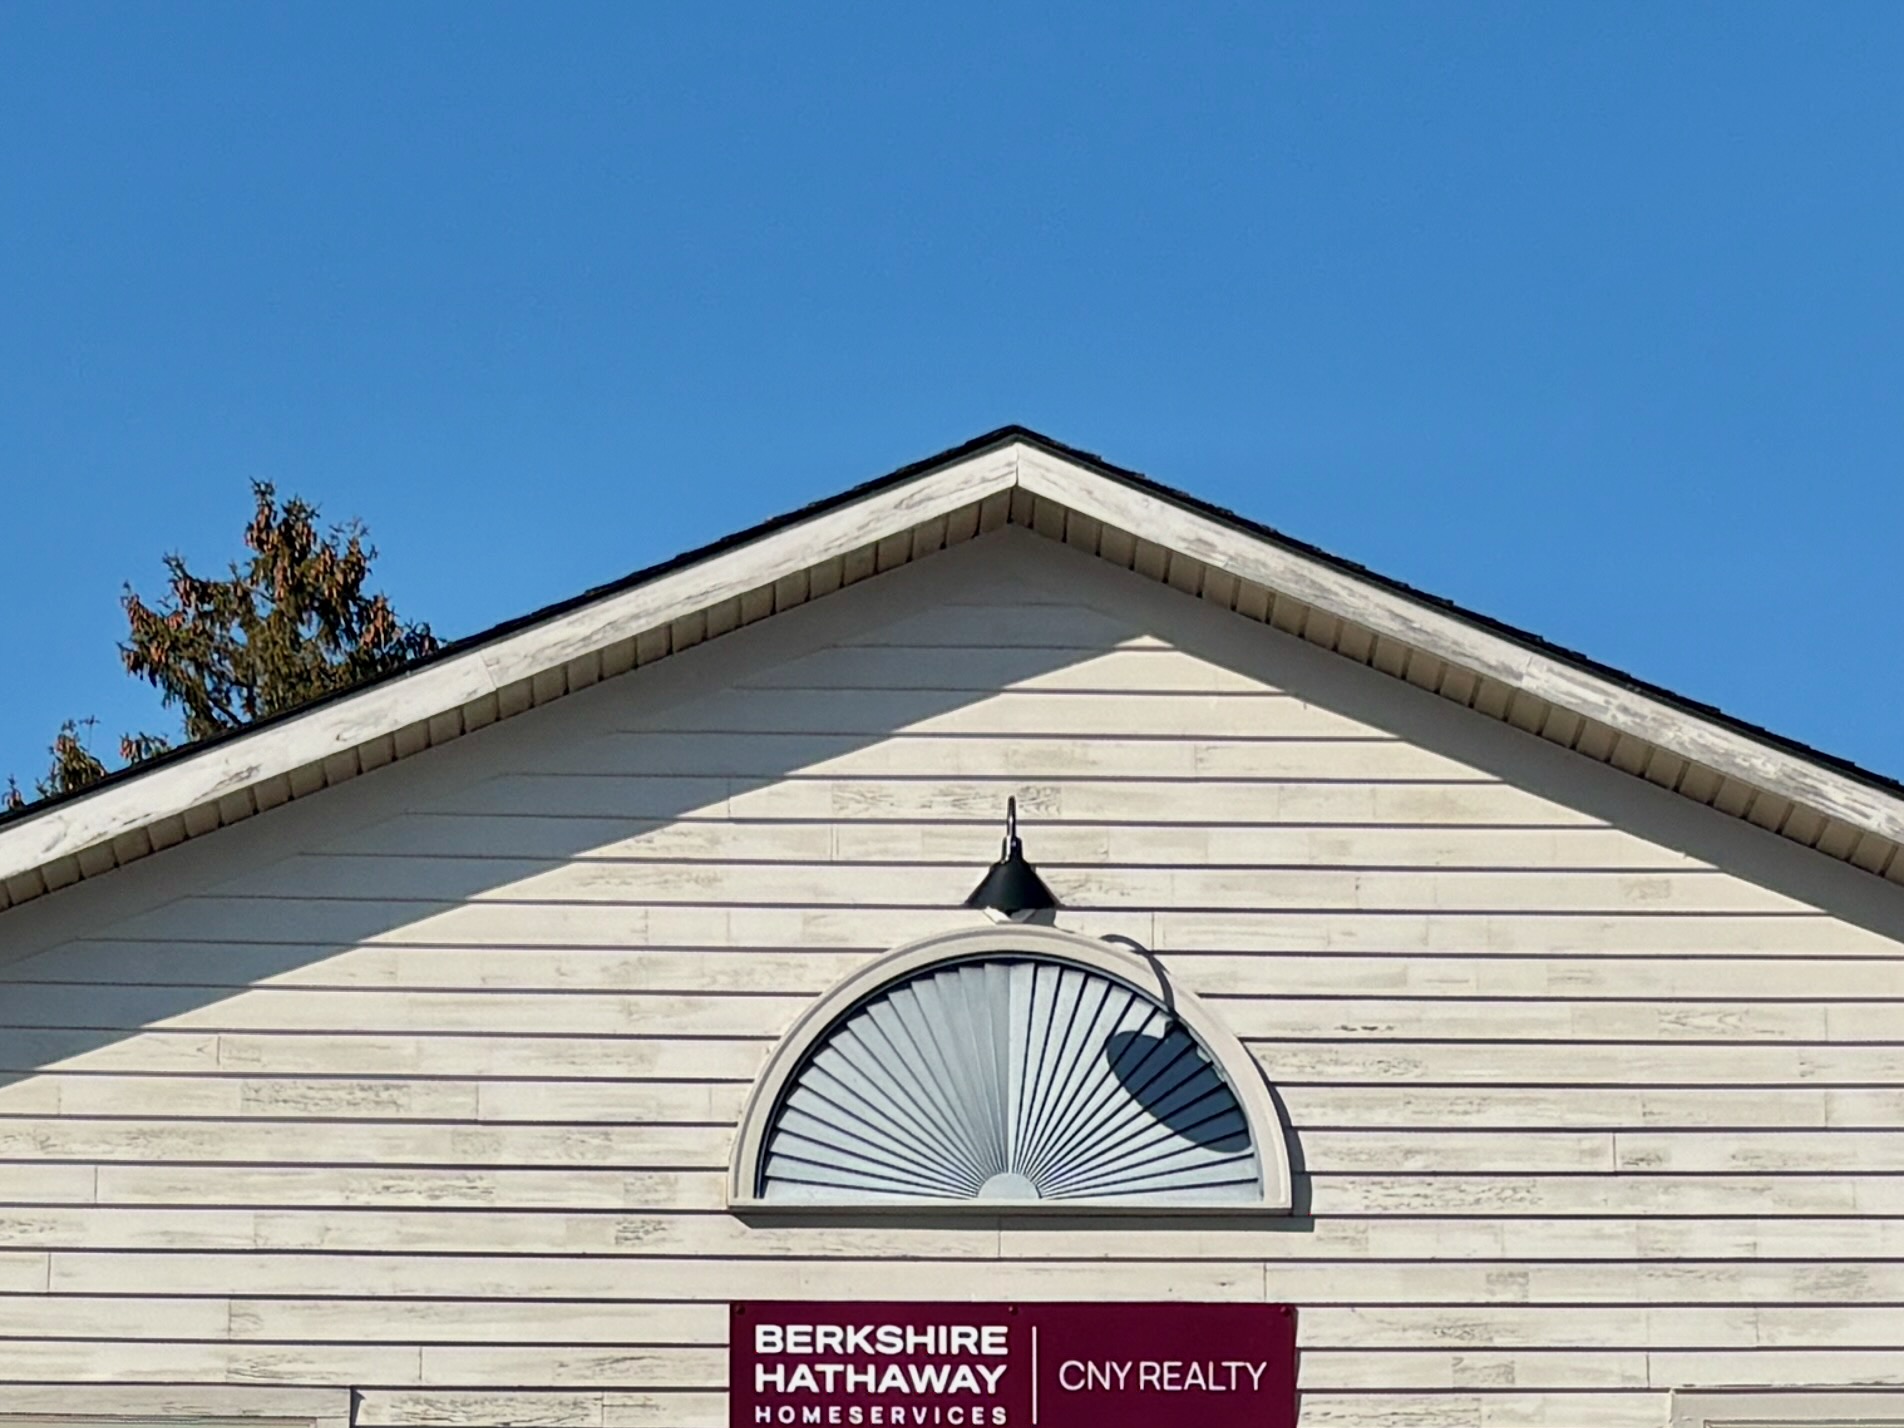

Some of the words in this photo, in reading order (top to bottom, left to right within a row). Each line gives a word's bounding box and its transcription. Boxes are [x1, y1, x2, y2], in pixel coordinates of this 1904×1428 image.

[755, 1324, 1009, 1356] BERKSHIRE
[755, 1363, 1008, 1395] HATHAWAY
[1058, 1360, 1133, 1392] CNY
[1139, 1360, 1268, 1392] REALTY
[755, 1405, 1008, 1426] HOMESERVICES
